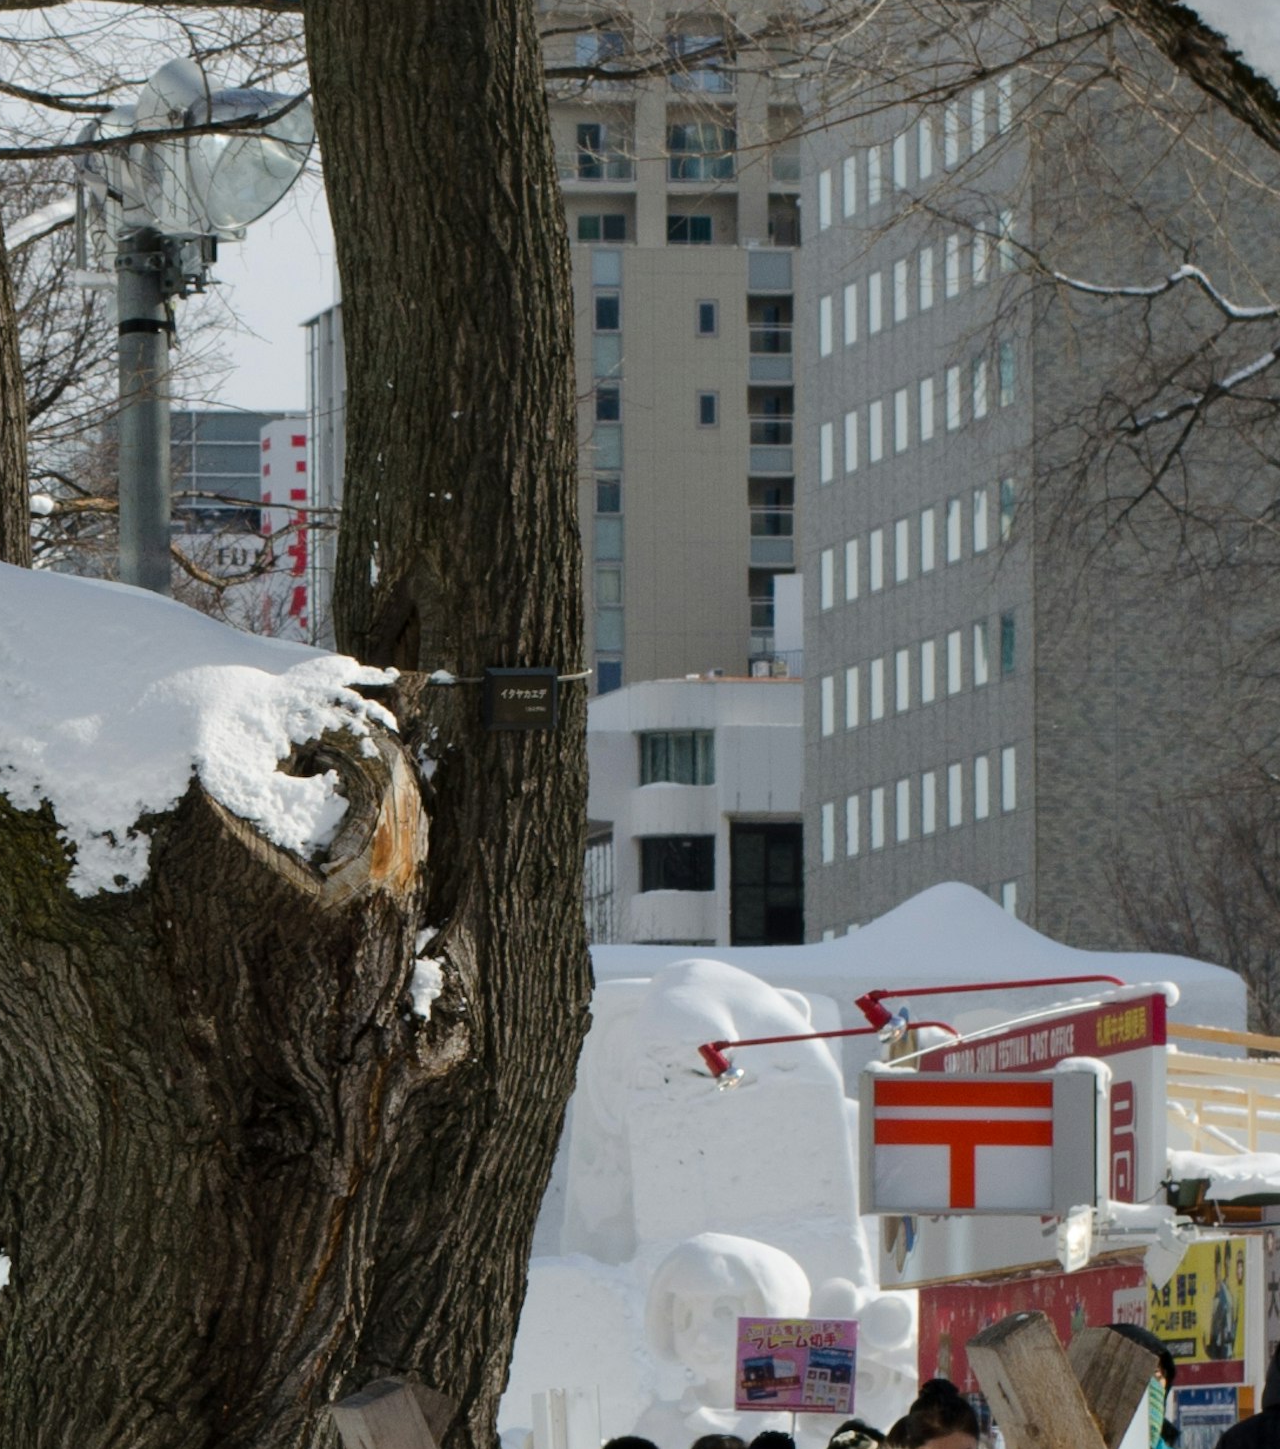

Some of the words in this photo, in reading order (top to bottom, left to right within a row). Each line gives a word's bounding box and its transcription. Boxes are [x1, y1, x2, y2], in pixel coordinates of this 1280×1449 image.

[500, 689, 547, 700] イタヤカエデ
[998, 1035, 1029, 1070] FESTIVAL
[1030, 1029, 1049, 1062] POST
[1050, 1023, 1075, 1058] OFFICE
[751, 1332, 837, 1350] フレーム切手
